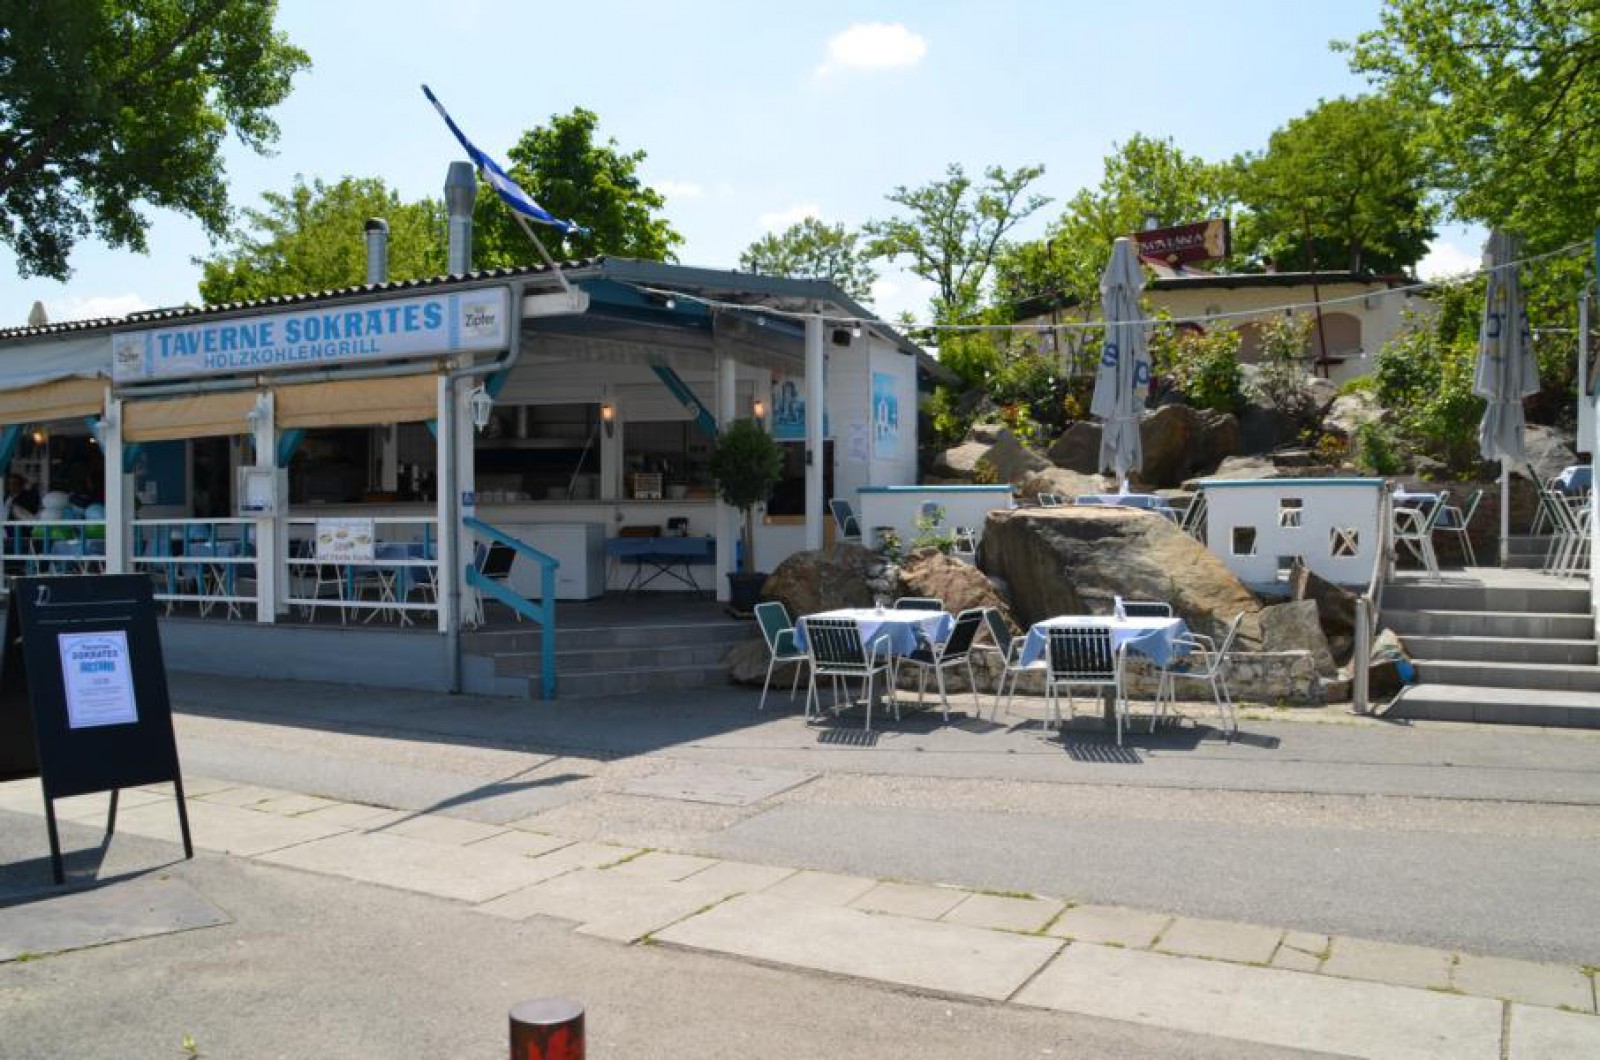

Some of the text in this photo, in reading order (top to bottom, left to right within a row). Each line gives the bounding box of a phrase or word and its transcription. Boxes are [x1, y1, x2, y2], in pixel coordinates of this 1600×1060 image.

[157, 301, 443, 358] TAVERNE SOKRATES
[204, 338, 380, 369] HOLZKOHLENGRILL
